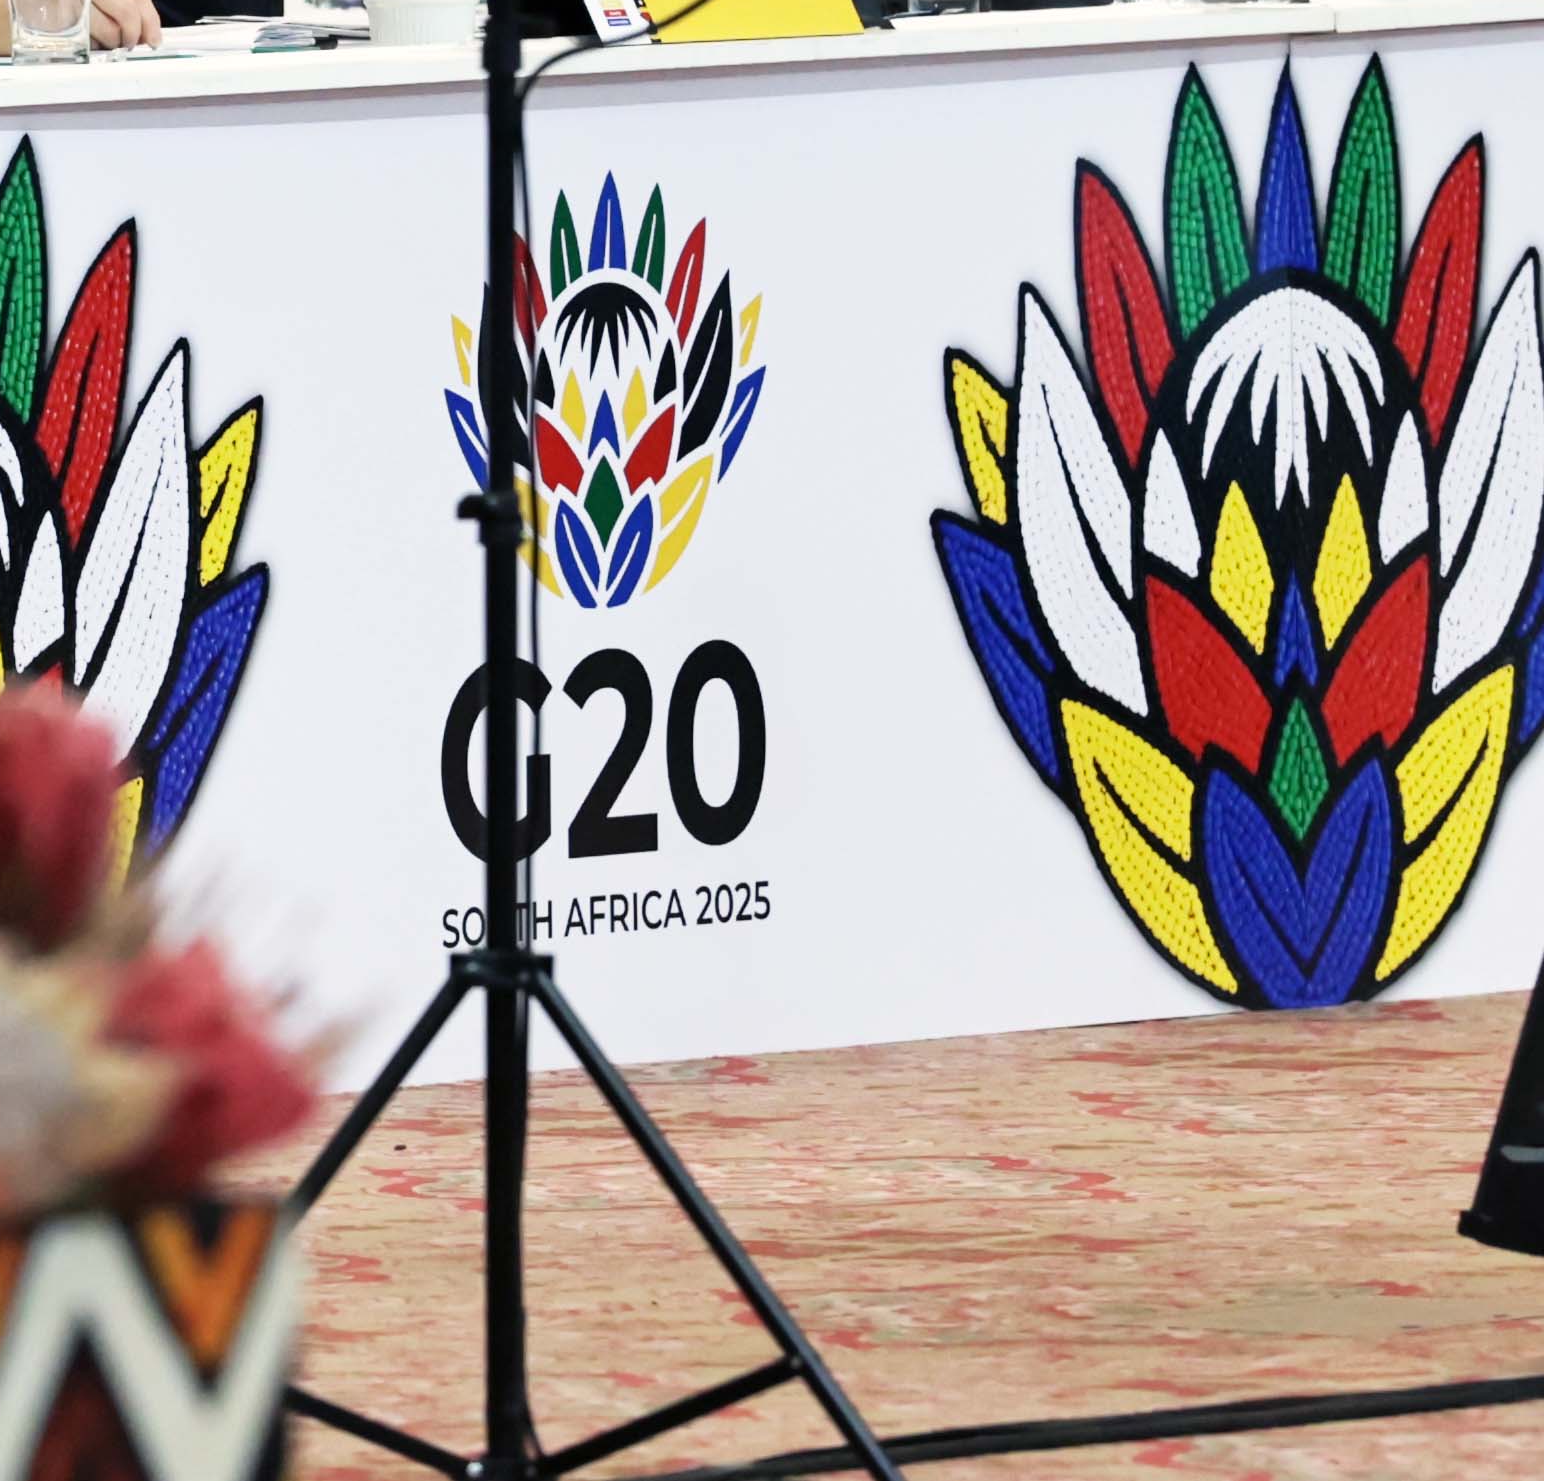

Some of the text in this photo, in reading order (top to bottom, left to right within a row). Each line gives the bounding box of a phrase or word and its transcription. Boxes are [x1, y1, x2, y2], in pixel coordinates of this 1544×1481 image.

[440, 638, 767, 864] G20
[441, 880, 772, 949] SOTH AFRICA 2025
